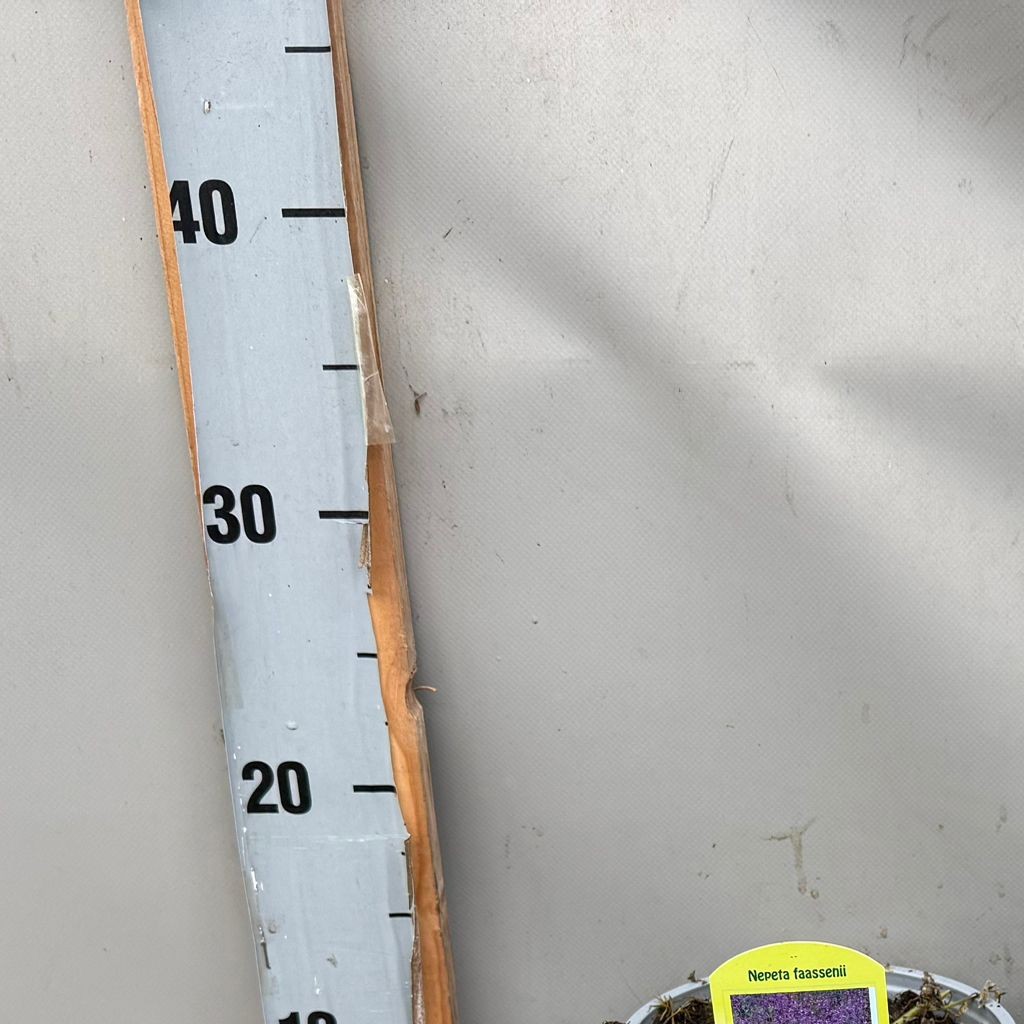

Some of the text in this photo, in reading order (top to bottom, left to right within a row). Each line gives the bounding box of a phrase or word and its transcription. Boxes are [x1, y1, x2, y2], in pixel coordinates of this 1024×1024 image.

[168, 178, 238, 246] 40
[202, 484, 276, 545] 30
[241, 760, 312, 815] 20
[748, 964, 847, 982] Nepeta faassenii
